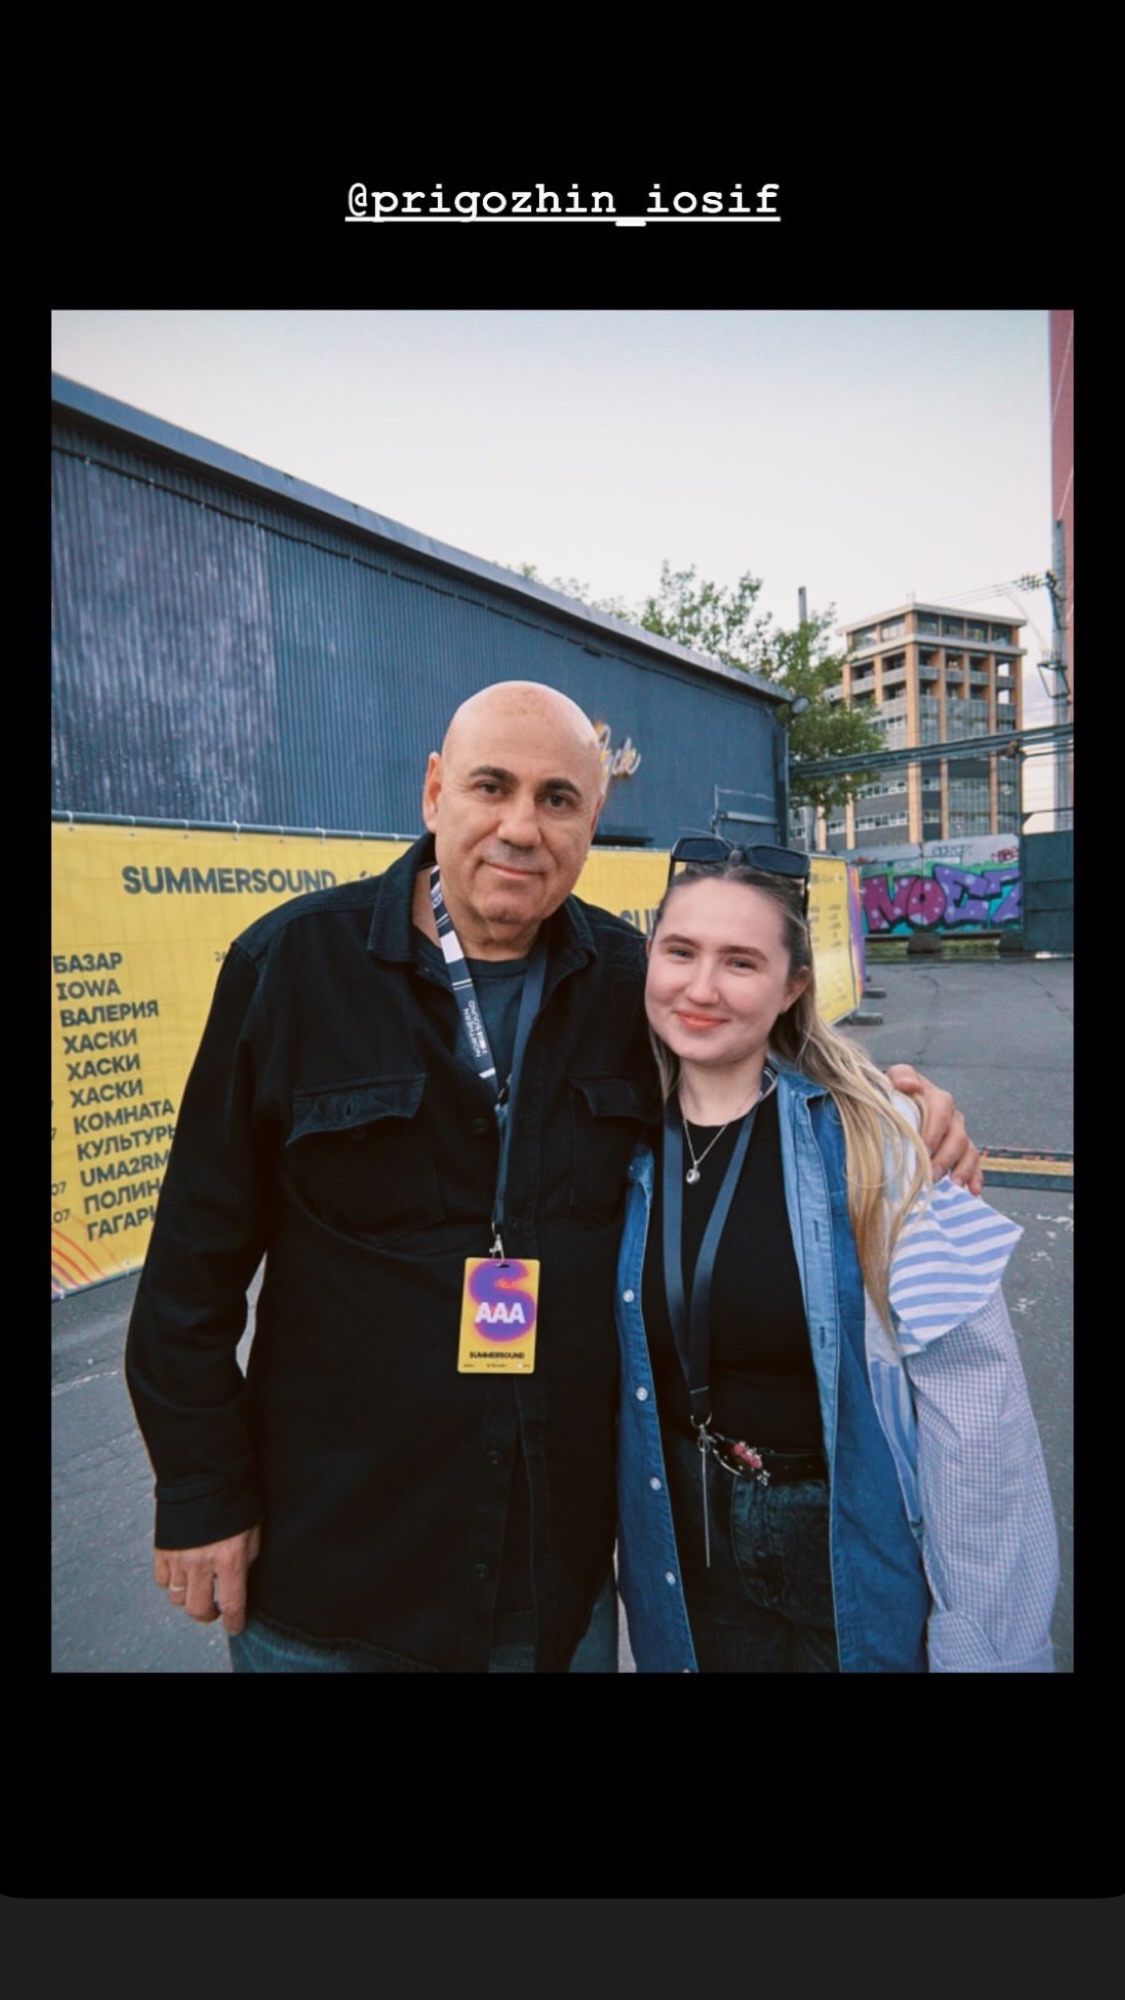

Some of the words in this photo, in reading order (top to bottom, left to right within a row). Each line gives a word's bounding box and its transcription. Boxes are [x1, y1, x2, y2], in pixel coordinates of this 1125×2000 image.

[121, 865, 337, 895] SUMMERSOUND
[52, 952, 123, 974] БАЗАР
[56, 978, 121, 1001] IOWA
[60, 1000, 159, 1028] ВАЛЕРИЯ
[62, 1028, 138, 1056] ХАСКИ
[65, 1053, 141, 1082] ХАСКИ
[69, 1078, 144, 1109] ХАСКИ
[73, 1099, 175, 1135] КОМНАТА
[474, 1302, 526, 1324] AAA
[469, 1351, 525, 1359] SUMMERSOUND
